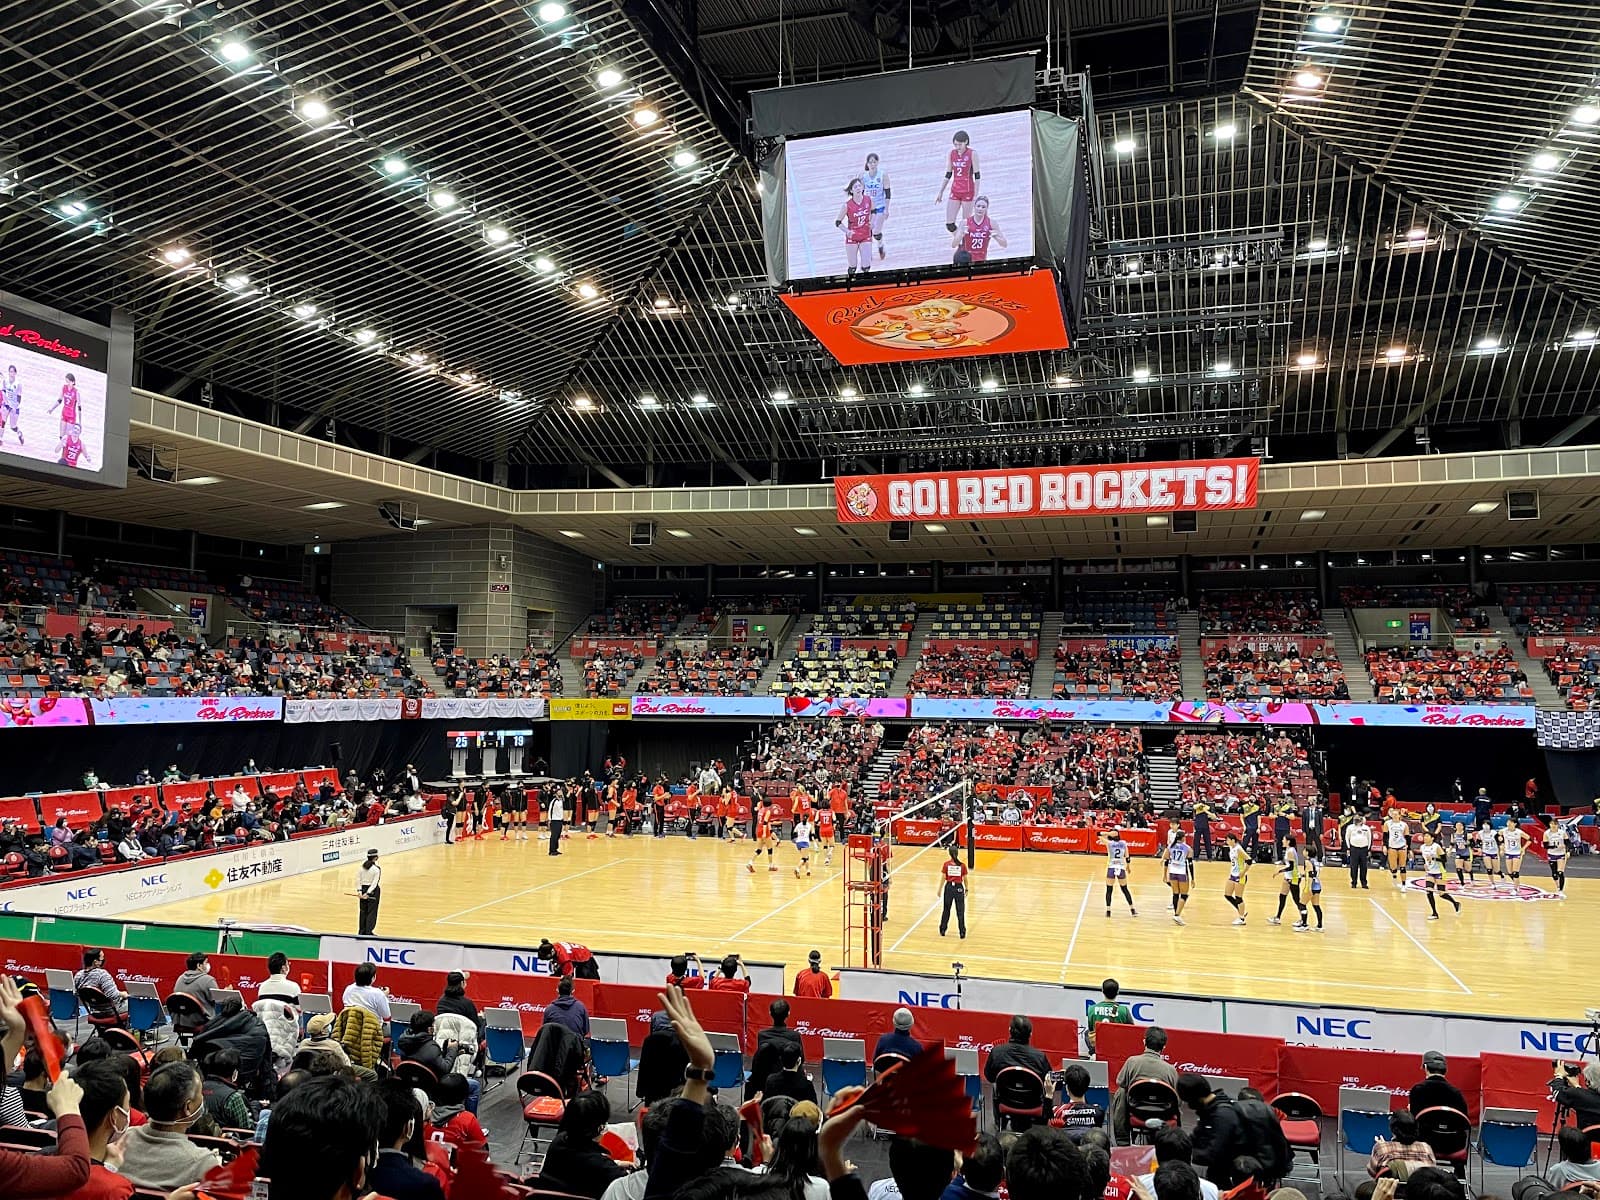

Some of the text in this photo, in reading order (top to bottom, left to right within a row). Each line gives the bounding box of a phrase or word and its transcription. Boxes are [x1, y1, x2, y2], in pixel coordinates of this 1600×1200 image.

[957, 168, 962, 177] 2
[972, 239, 983, 249] 23
[888, 465, 1248, 515] GO! RED ROCKETS!
[197, 707, 227, 719] Red
[633, 704, 661, 713] Red
[1421, 714, 1526, 725] Red Rockets
[456, 737, 467, 748] 25
[514, 736, 524, 747] 19
[400, 826, 416, 836] NEC
[1115, 849, 1121, 859] 2
[1172, 850, 1183, 861] 17
[227, 859, 283, 883] 住友不動産
[141, 873, 168, 887] NEC
[67, 887, 97, 900] NEC
[367, 947, 416, 965] NEC
[512, 955, 553, 973] NE
[116, 973, 132, 981] Red
[499, 1002, 547, 1012] Red Rocke
[1094, 1006, 1118, 1017] PRES
[794, 1027, 855, 1038] Red Rockets
[1296, 1016, 1372, 1039] NEC
[956, 1041, 978, 1051] Red
[1520, 1030, 1598, 1055] NEC
[1179, 1062, 1223, 1074] Rockets
[1066, 1117, 1095, 1126] SAWADA
